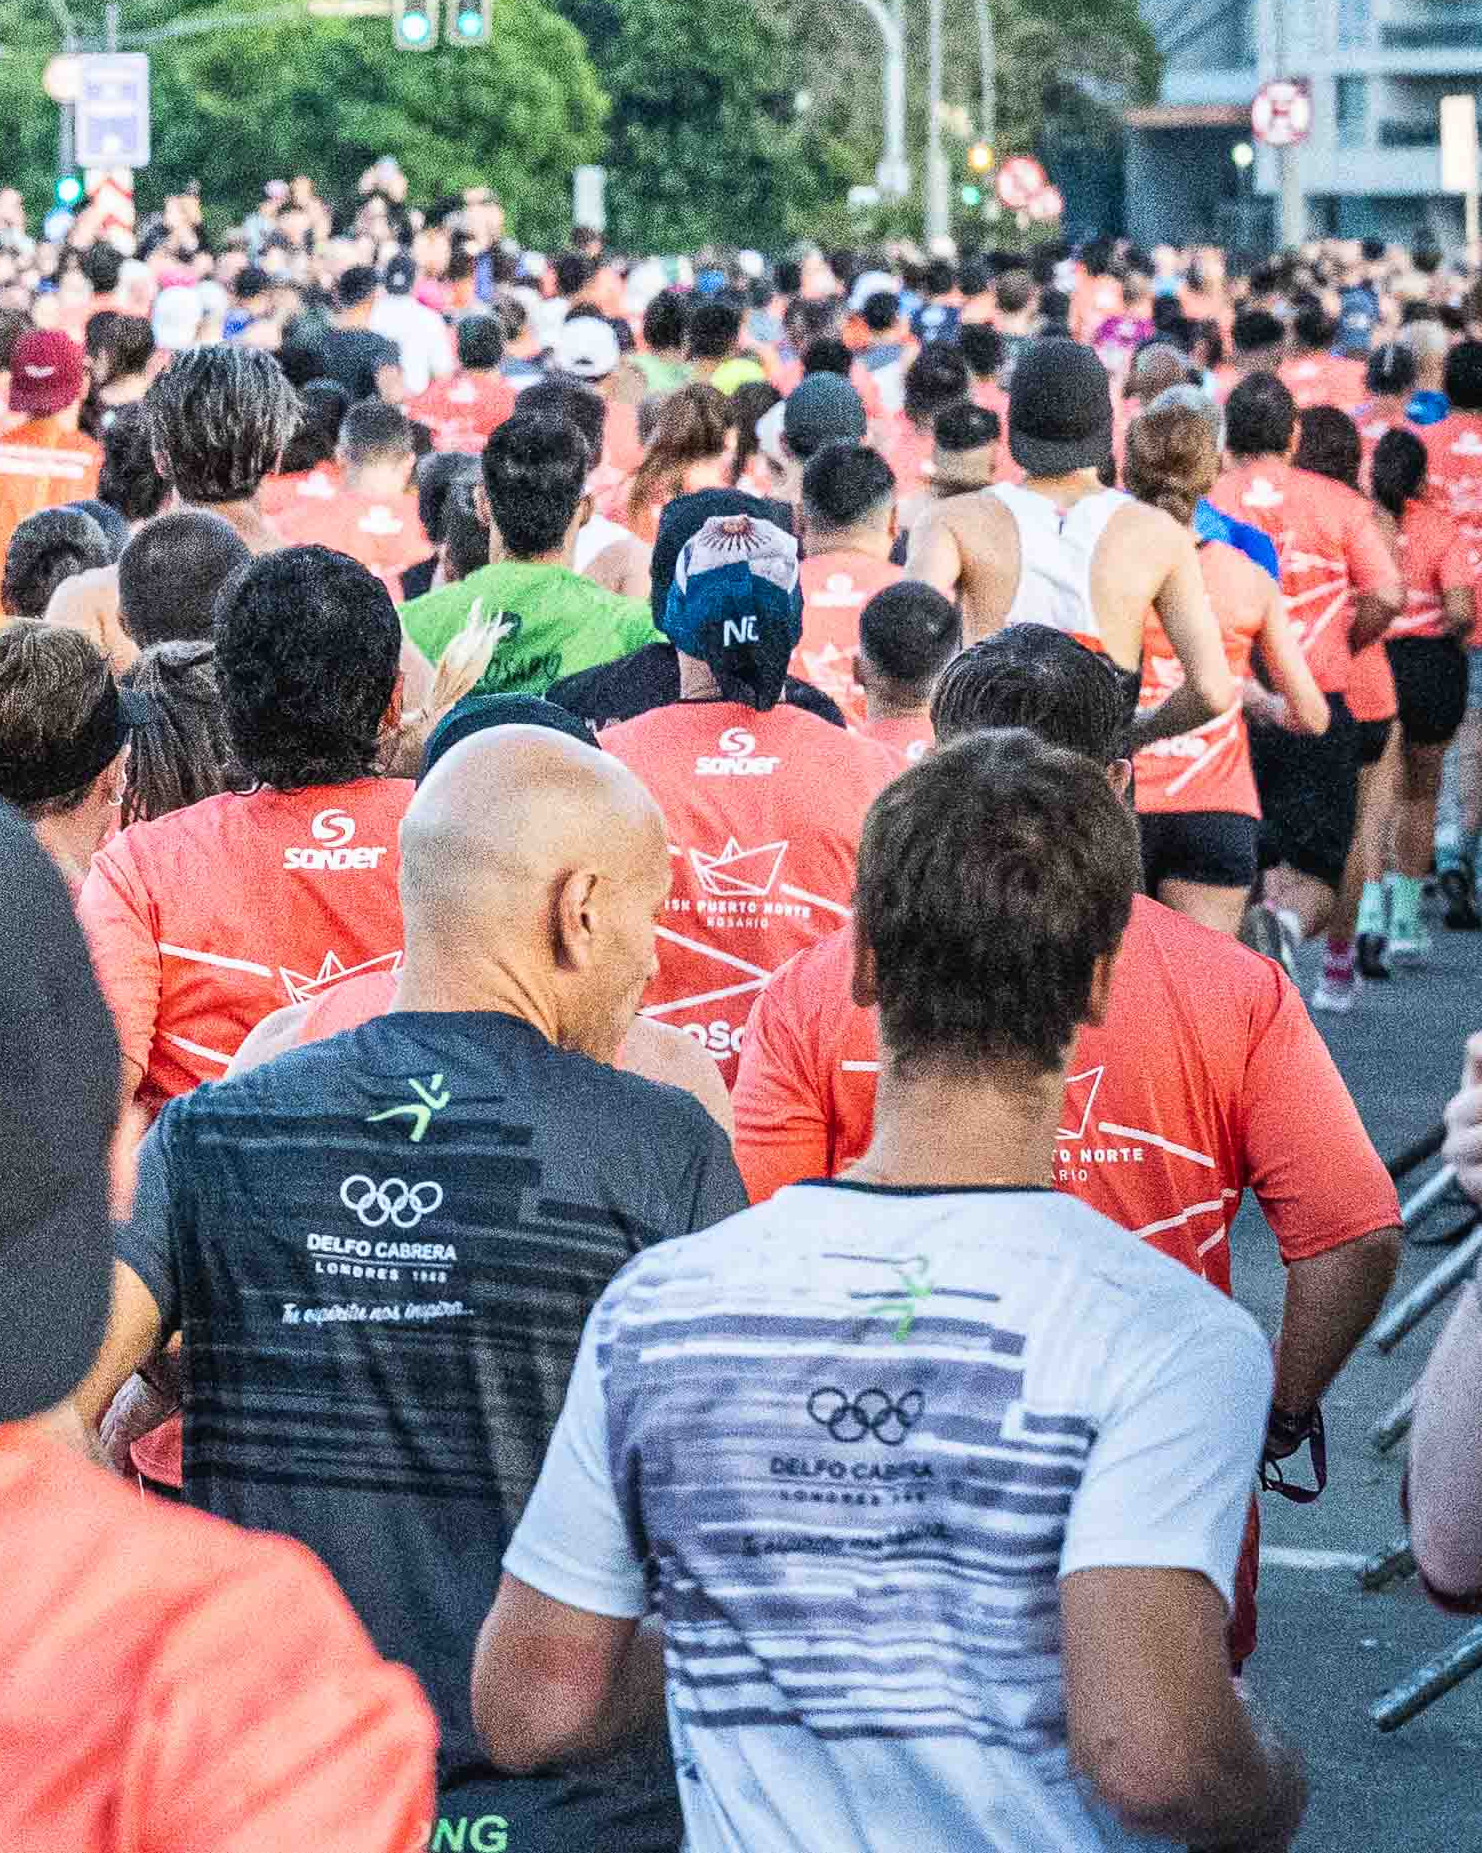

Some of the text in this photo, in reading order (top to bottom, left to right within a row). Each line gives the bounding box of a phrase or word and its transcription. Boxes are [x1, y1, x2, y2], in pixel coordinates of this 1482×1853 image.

[1080, 1147, 1144, 1164] NORTE
[306, 1231, 458, 1262] DELFO CABRERA
[314, 1260, 400, 1282] LONDRES
